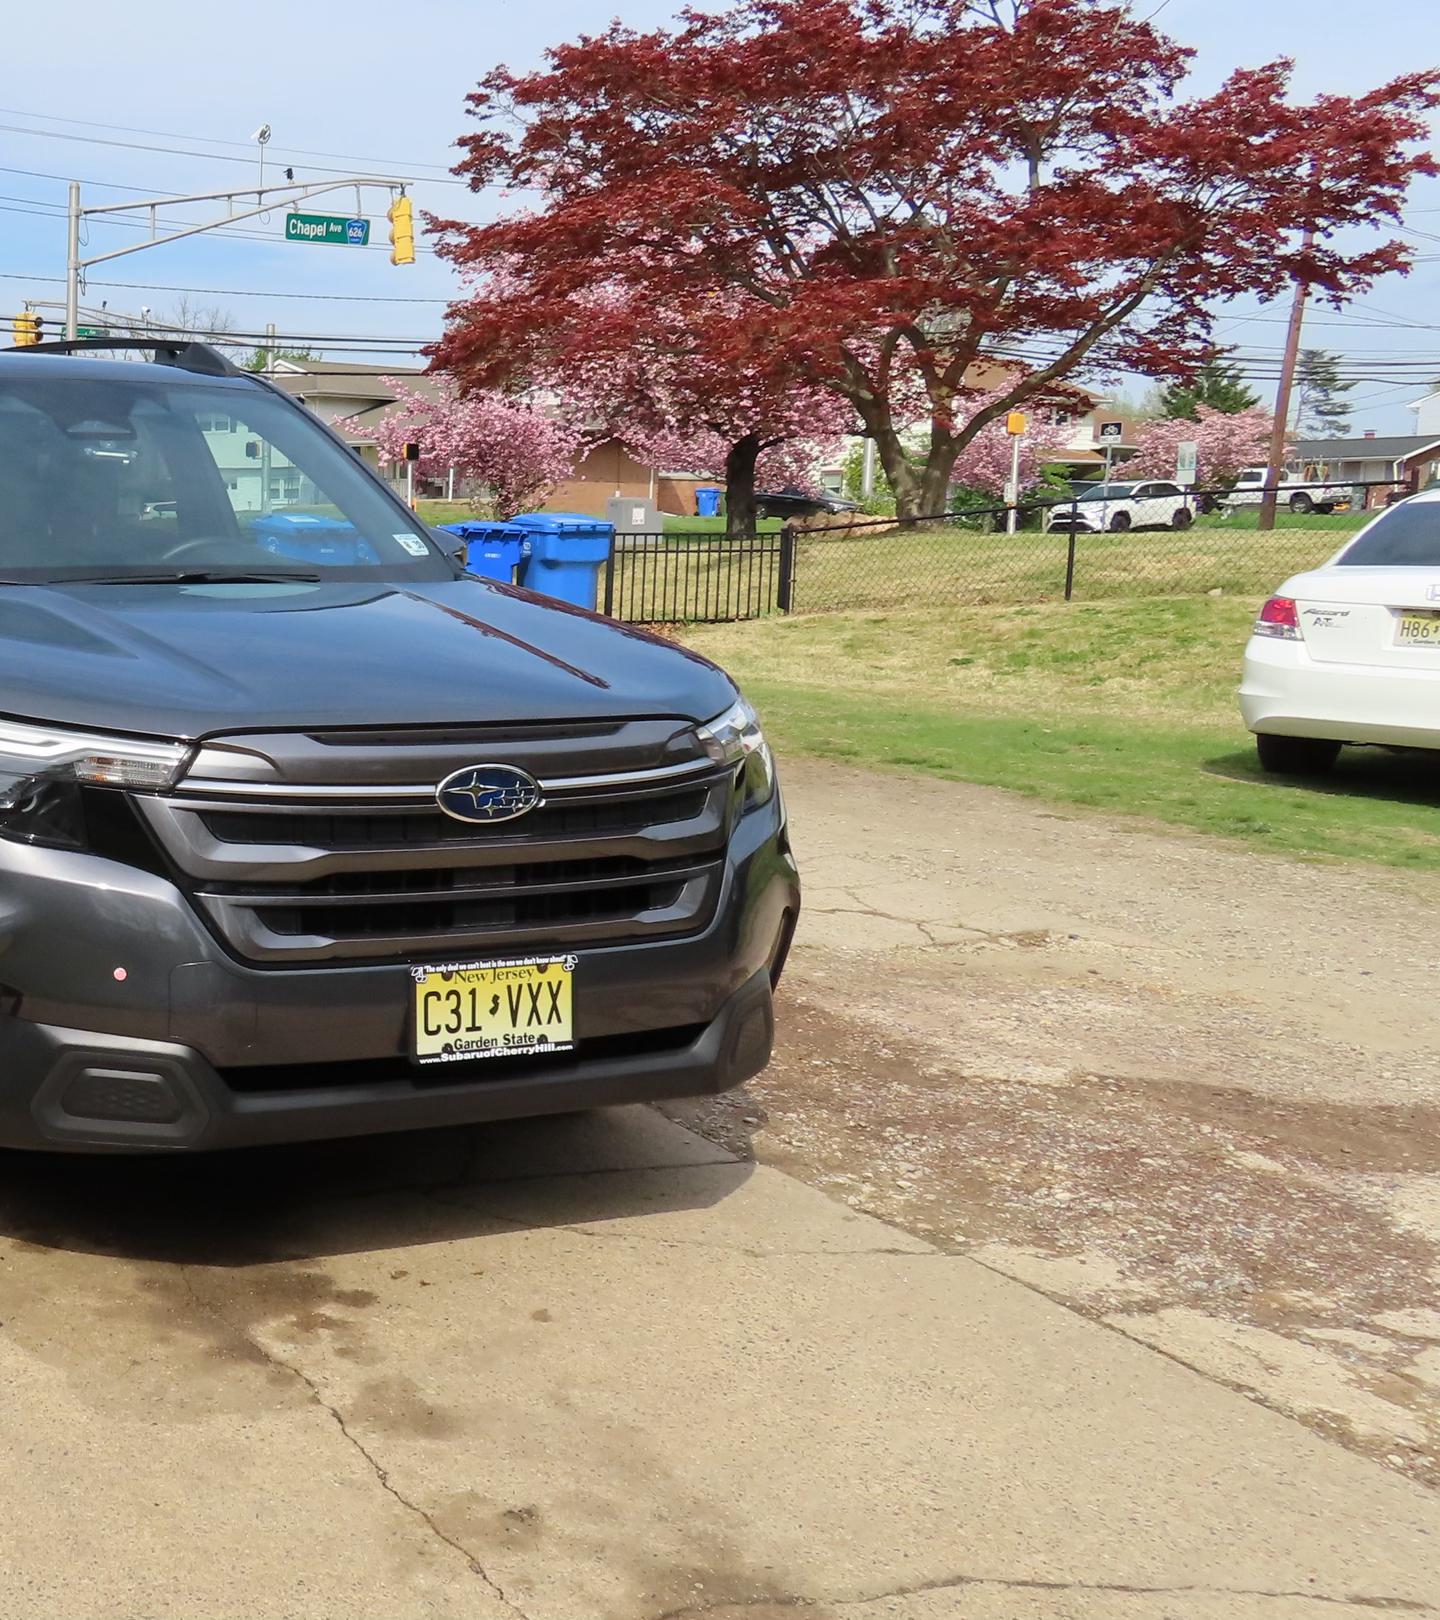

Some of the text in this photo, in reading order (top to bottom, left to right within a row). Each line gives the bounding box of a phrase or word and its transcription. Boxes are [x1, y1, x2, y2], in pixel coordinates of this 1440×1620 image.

[289, 218, 343, 239] Chapel Ave
[348, 227, 363, 237] 626
[1302, 608, 1351, 617] Accord
[1400, 619, 1430, 638] H86
[454, 967, 535, 984] New Jersey
[424, 980, 562, 1036] C31 VXX
[454, 1032, 536, 1050] Garden State
[419, 1044, 573, 1064] www.SubaruofCherryHill.com
